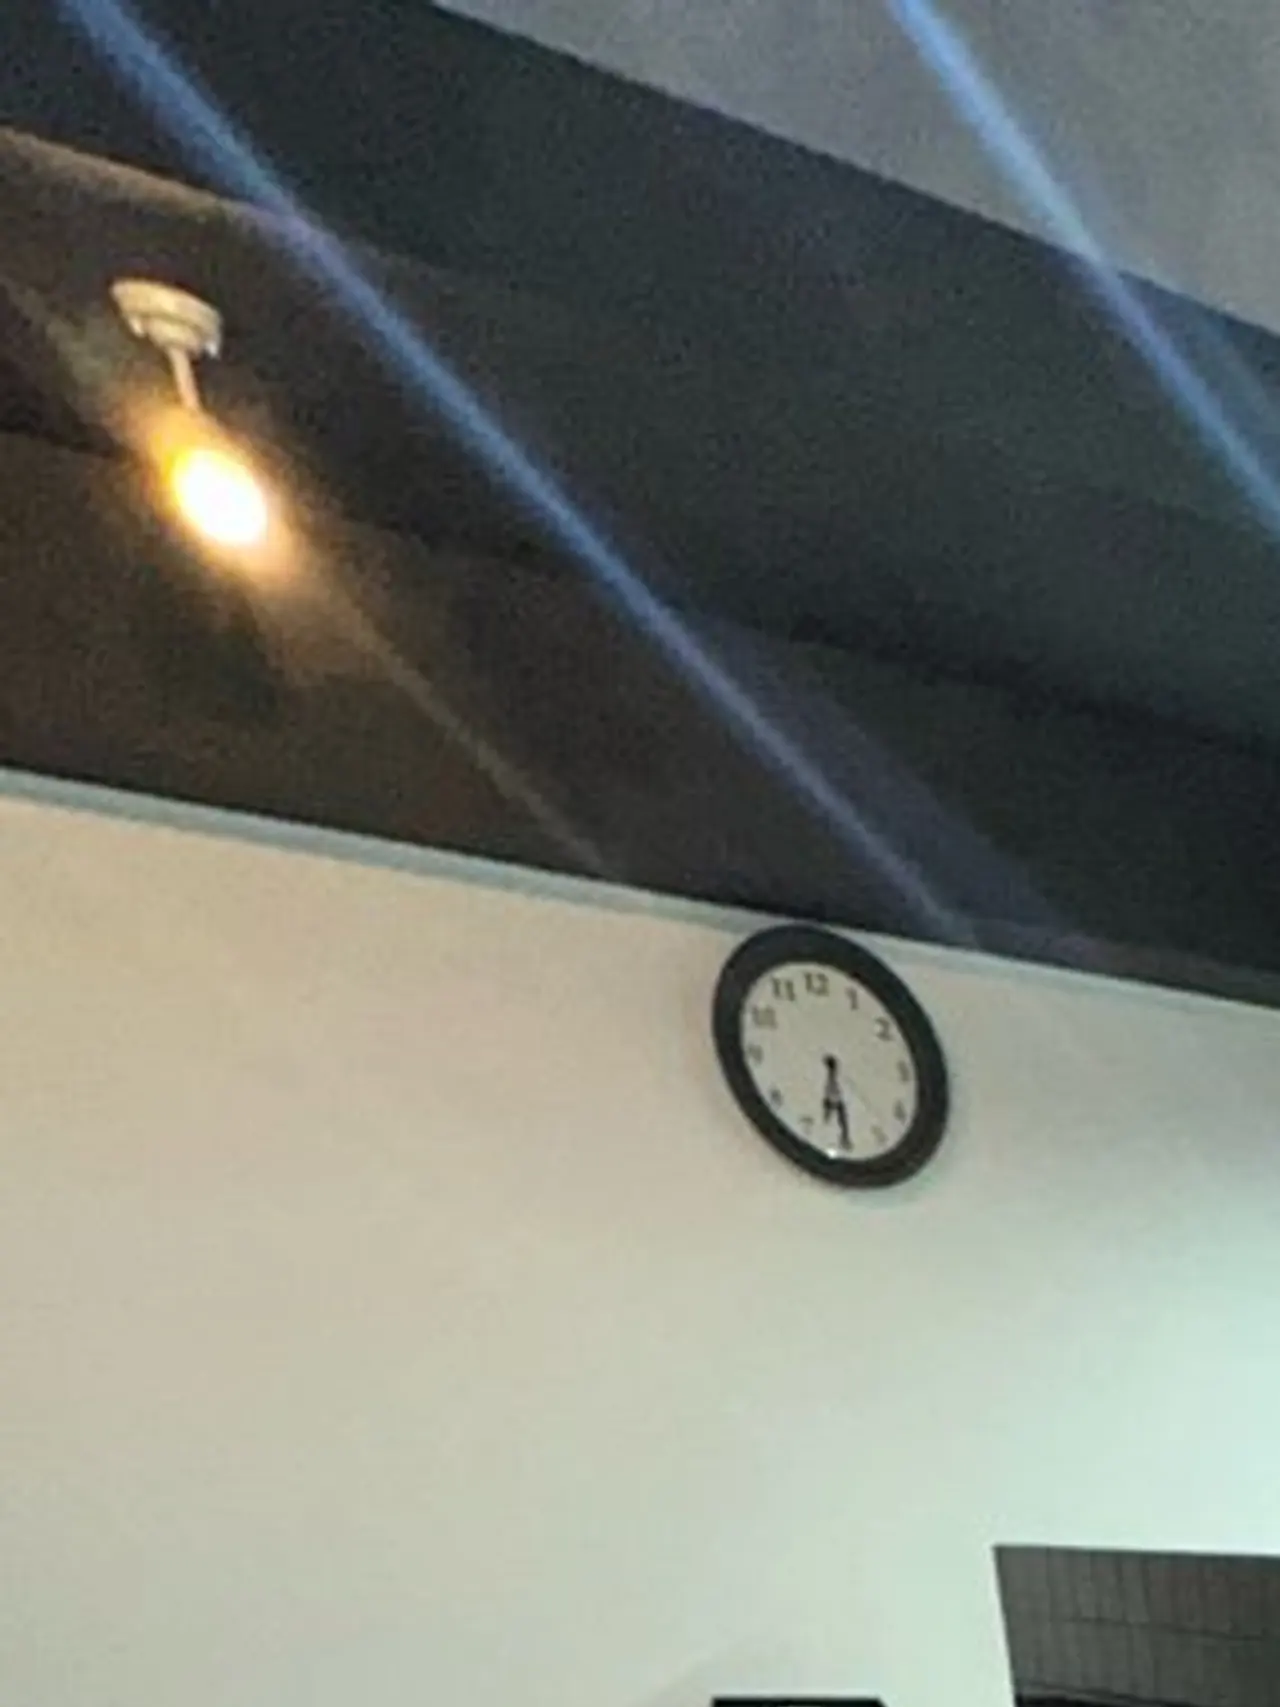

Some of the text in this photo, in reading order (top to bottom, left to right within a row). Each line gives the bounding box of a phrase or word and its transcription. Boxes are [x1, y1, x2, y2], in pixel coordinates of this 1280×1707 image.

[772, 976, 797, 1002] 11
[804, 971, 830, 996] 12
[844, 986, 859, 1011] 1
[874, 1016, 896, 1042] 2
